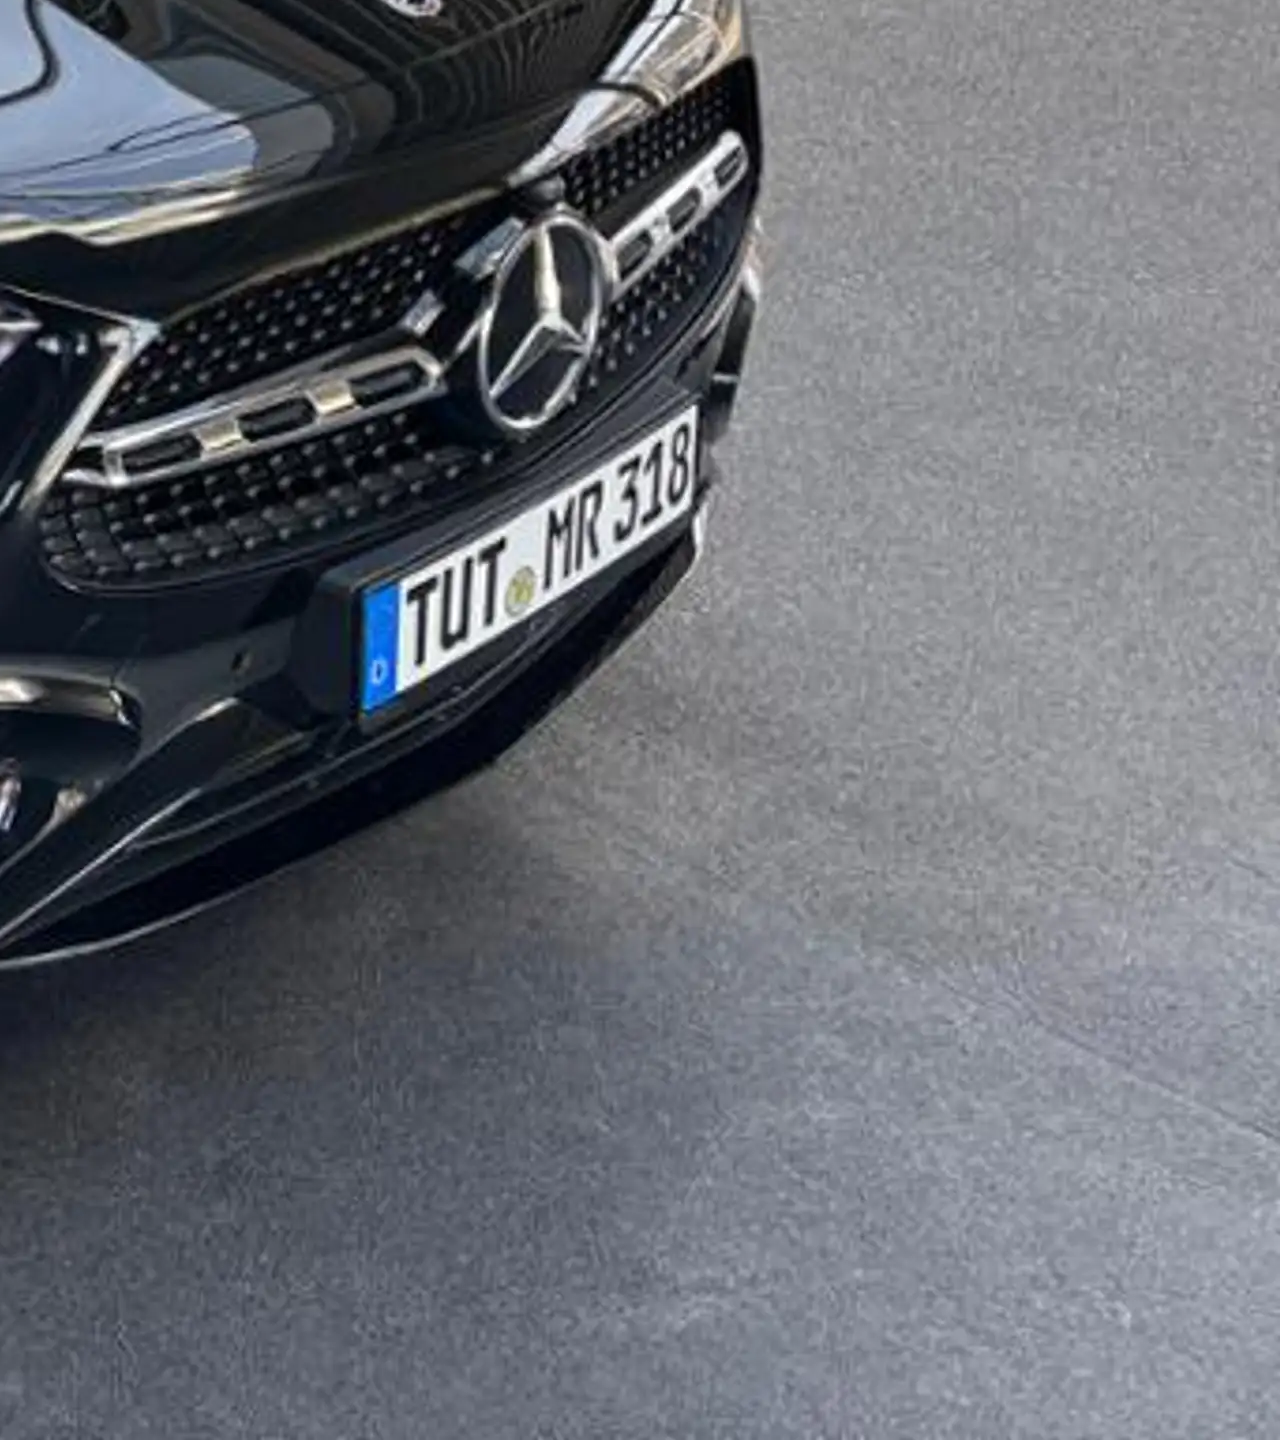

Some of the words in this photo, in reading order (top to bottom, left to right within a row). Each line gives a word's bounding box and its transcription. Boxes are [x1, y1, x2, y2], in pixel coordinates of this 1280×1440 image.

[407, 536, 506, 667] TUT
[544, 480, 603, 589] MR
[614, 423, 690, 542] 318
[372, 659, 388, 686] D
